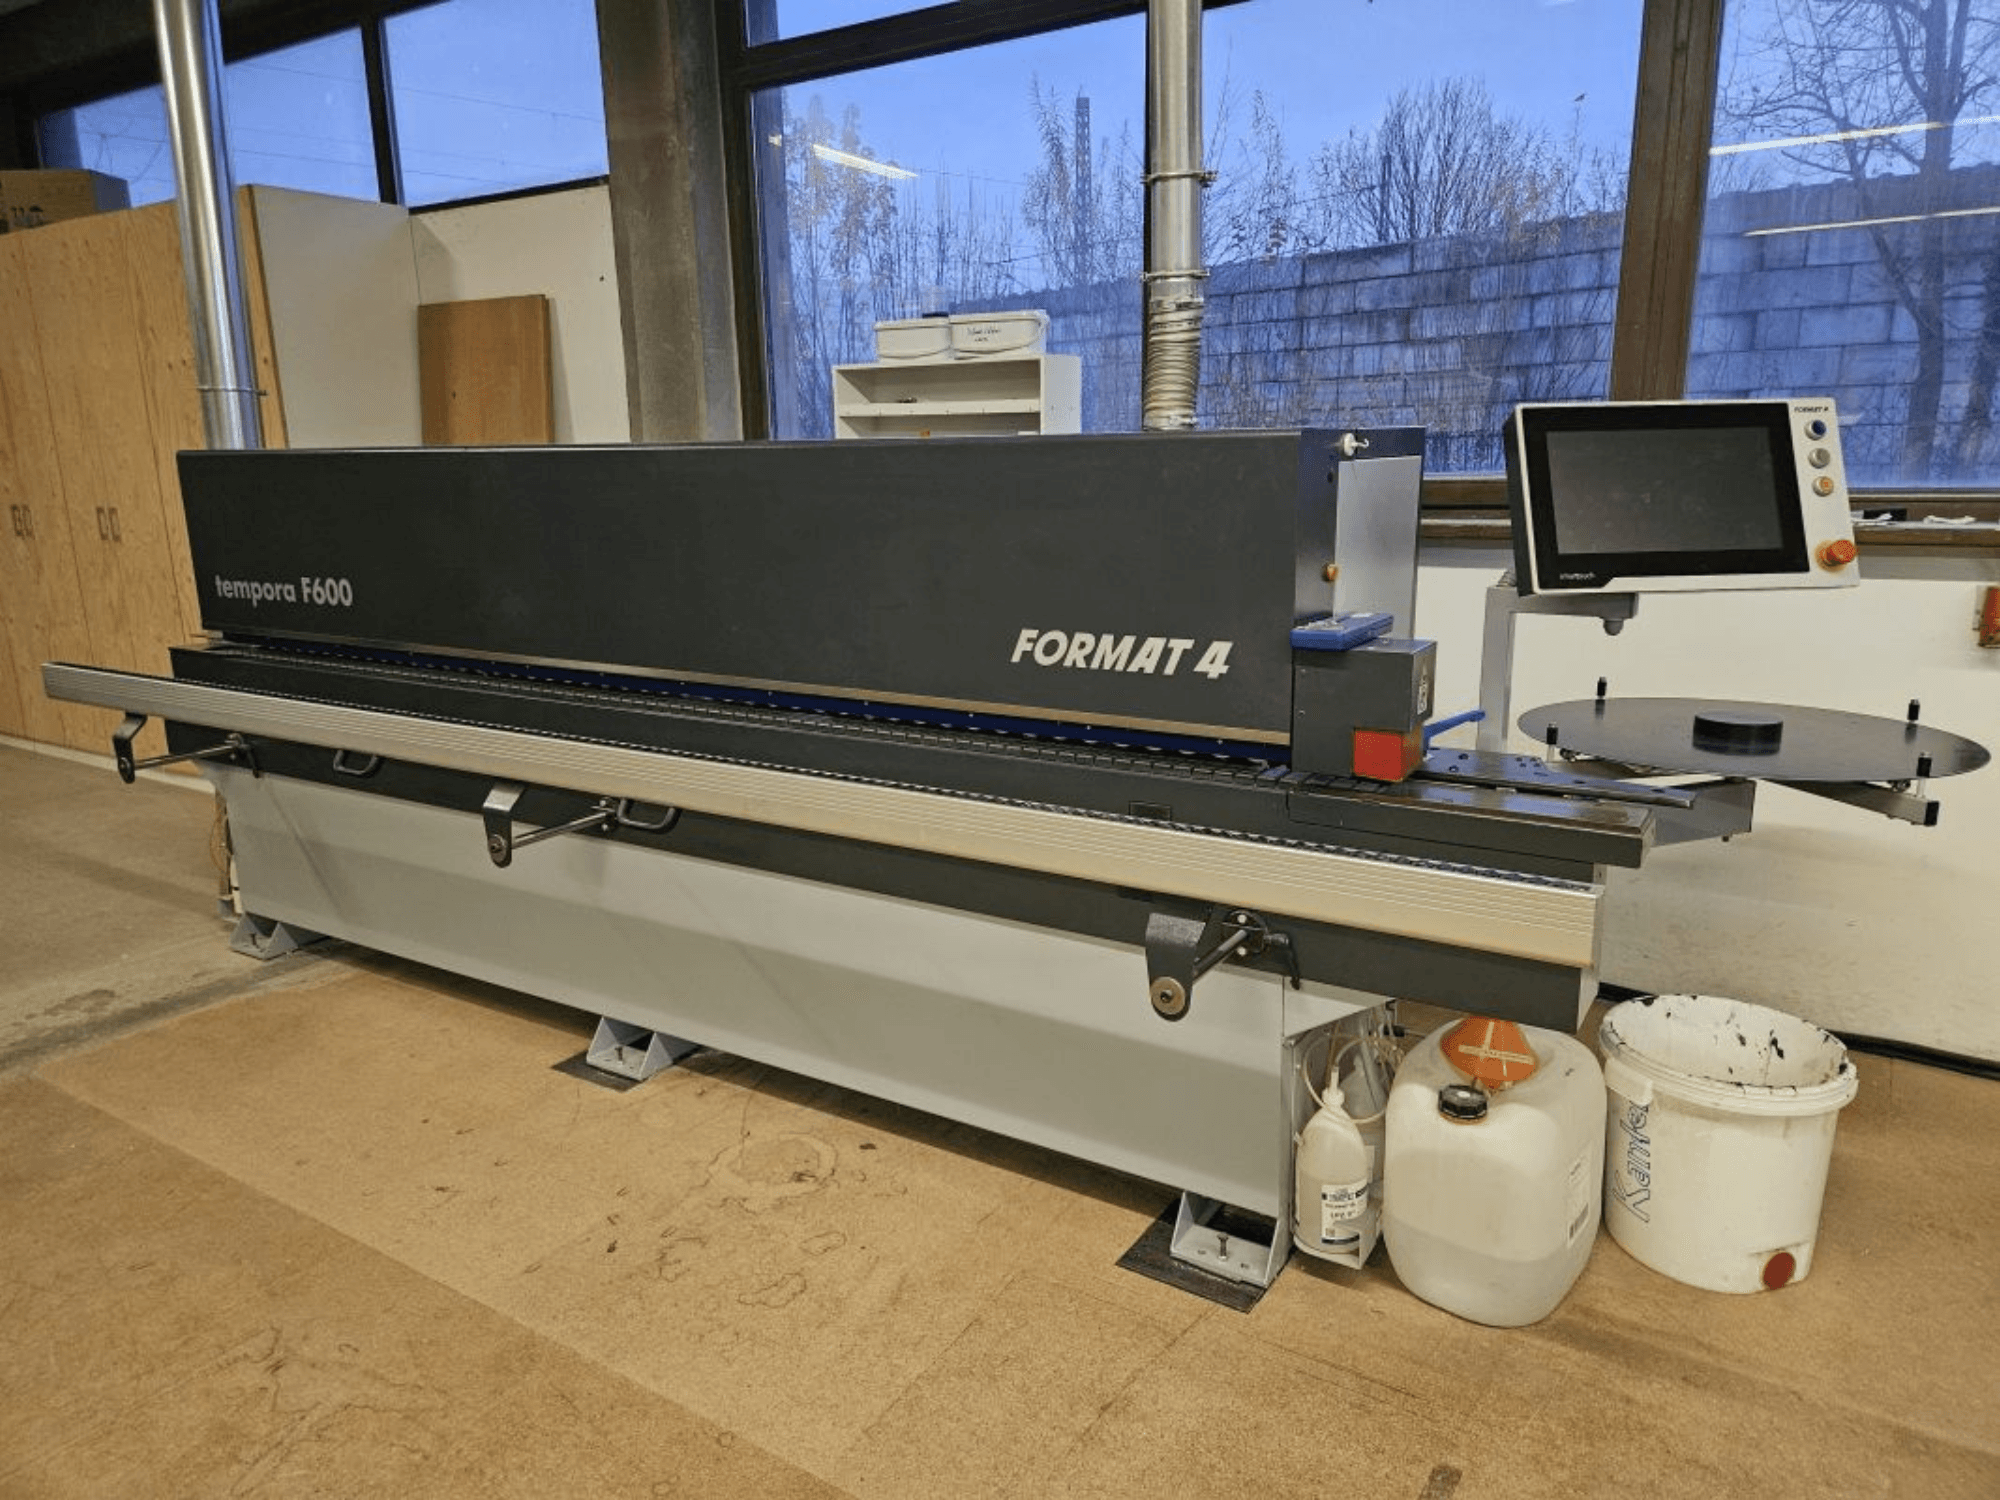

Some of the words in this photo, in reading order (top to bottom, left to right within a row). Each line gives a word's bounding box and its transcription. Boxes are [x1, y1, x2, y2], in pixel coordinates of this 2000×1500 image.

[215, 575, 297, 608] tempora
[301, 577, 353, 606] F600
[1010, 628, 1195, 676] FORMAT
[1193, 640, 1234, 679] 4
